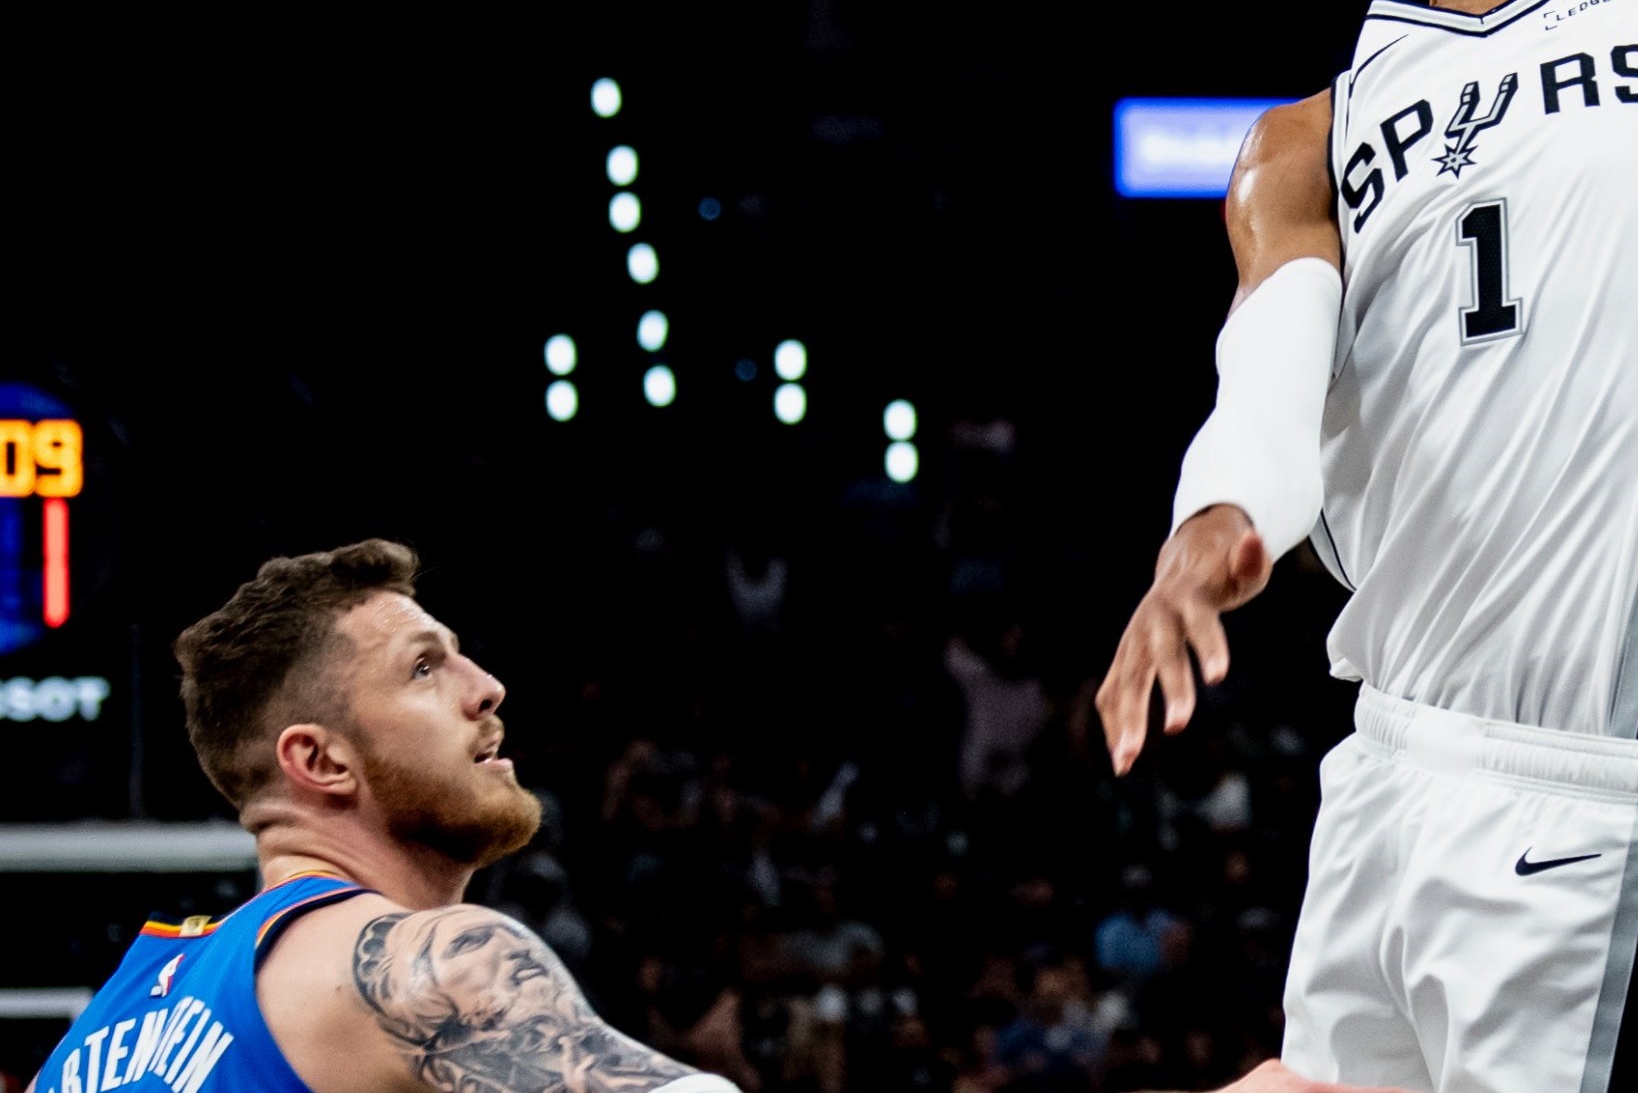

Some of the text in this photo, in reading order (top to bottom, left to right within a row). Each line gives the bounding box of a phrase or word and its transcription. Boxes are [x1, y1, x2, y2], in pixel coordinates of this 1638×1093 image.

[1456, 197, 1523, 346] 1
[0, 419, 83, 497] 09
[0, 676, 110, 722] SOT
